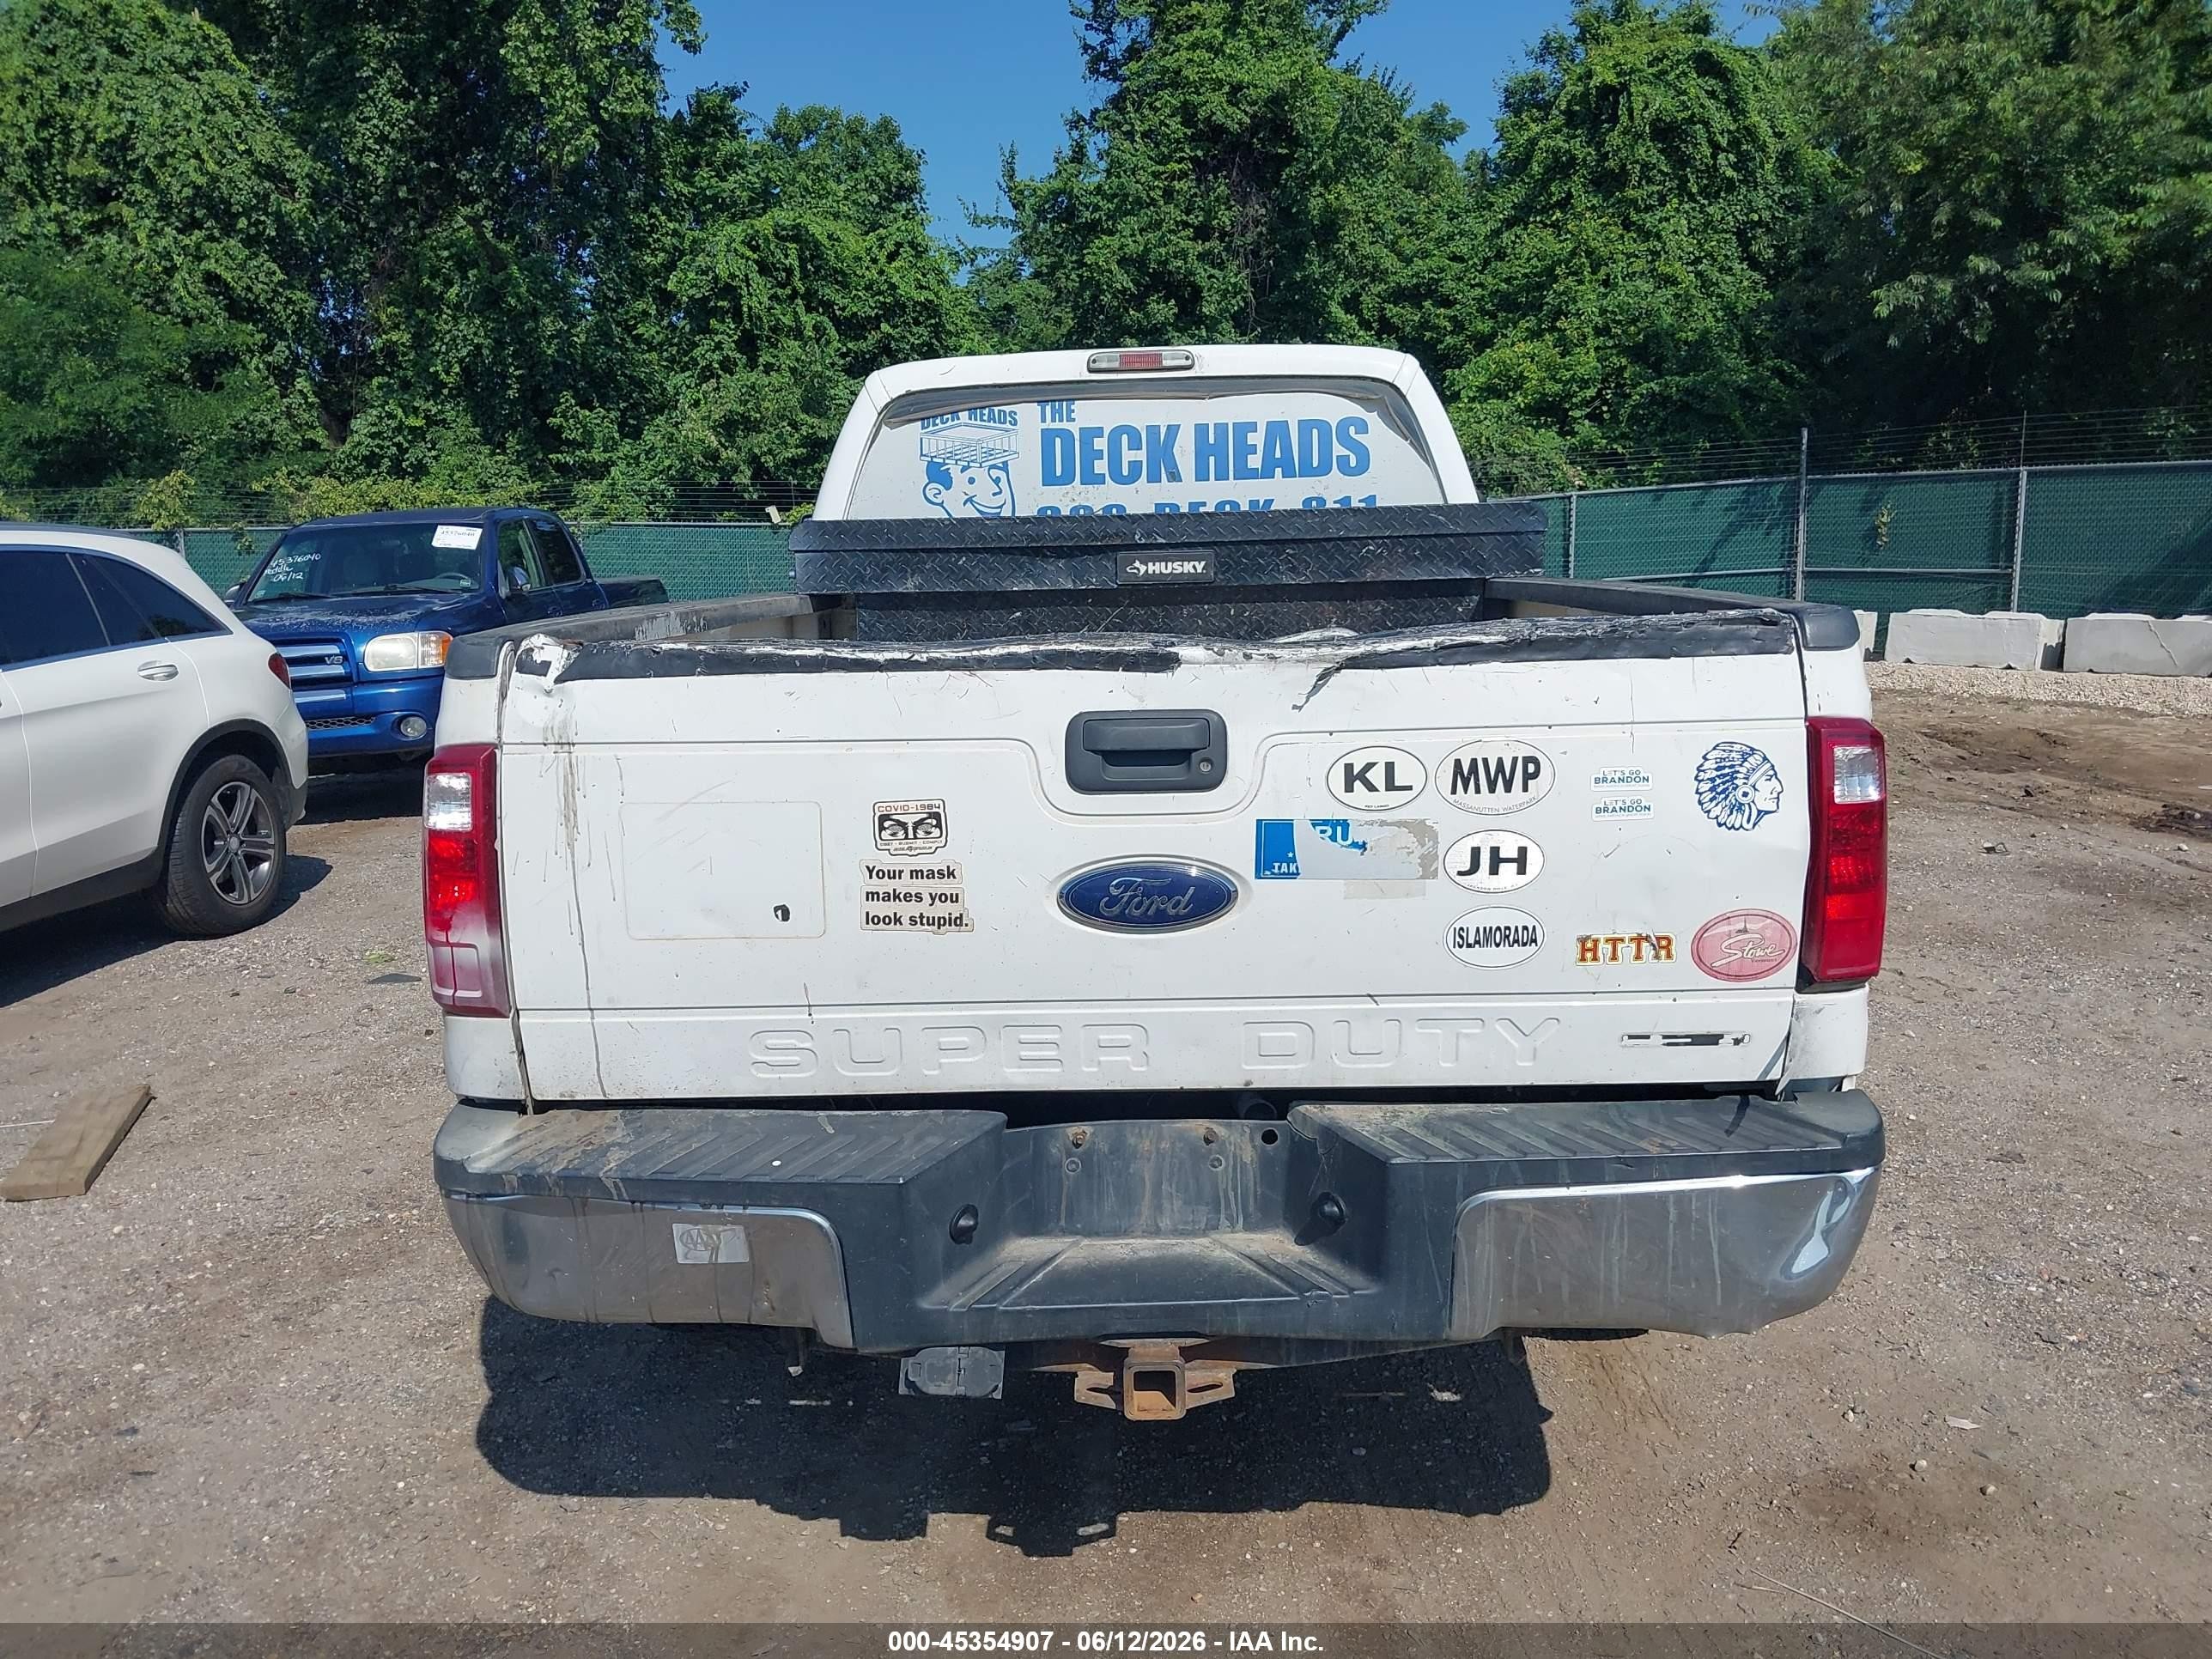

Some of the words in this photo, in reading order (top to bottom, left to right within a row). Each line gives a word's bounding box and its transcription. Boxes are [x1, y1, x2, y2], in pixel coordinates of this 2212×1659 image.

[921, 412, 961, 430] DECK
[968, 408, 1018, 427] HEADS
[1037, 401, 1076, 423] THE
[1041, 423, 1182, 487] DECK
[1194, 416, 1370, 482] HEADS
[273, 571, 304, 582] 06/12
[1343, 761, 1413, 793] KL
[1450, 755, 1541, 795] MWP
[1594, 775, 1650, 784] BRANDON
[878, 803, 941, 813] COVID-1984
[1453, 798, 1499, 813] MASSANUTTEN
[1503, 795, 1539, 812] WATERPARK
[1595, 805, 1651, 814] BRANDON
[1456, 846, 1528, 876] JH
[865, 865, 904, 880] Your
[909, 865, 957, 880] mask
[865, 888, 924, 902] makes
[928, 892, 959, 906] you
[1099, 877, 1195, 916] Ford
[865, 911, 903, 926] look
[908, 912, 969, 929] stupid.
[1453, 925, 1538, 949] ISLAMORADA
[1578, 934, 1674, 963] HTTR
[1711, 933, 1785, 967] Stowe
[748, 1021, 1150, 1079] SUPER
[1242, 1017, 1561, 1070] DUTY
